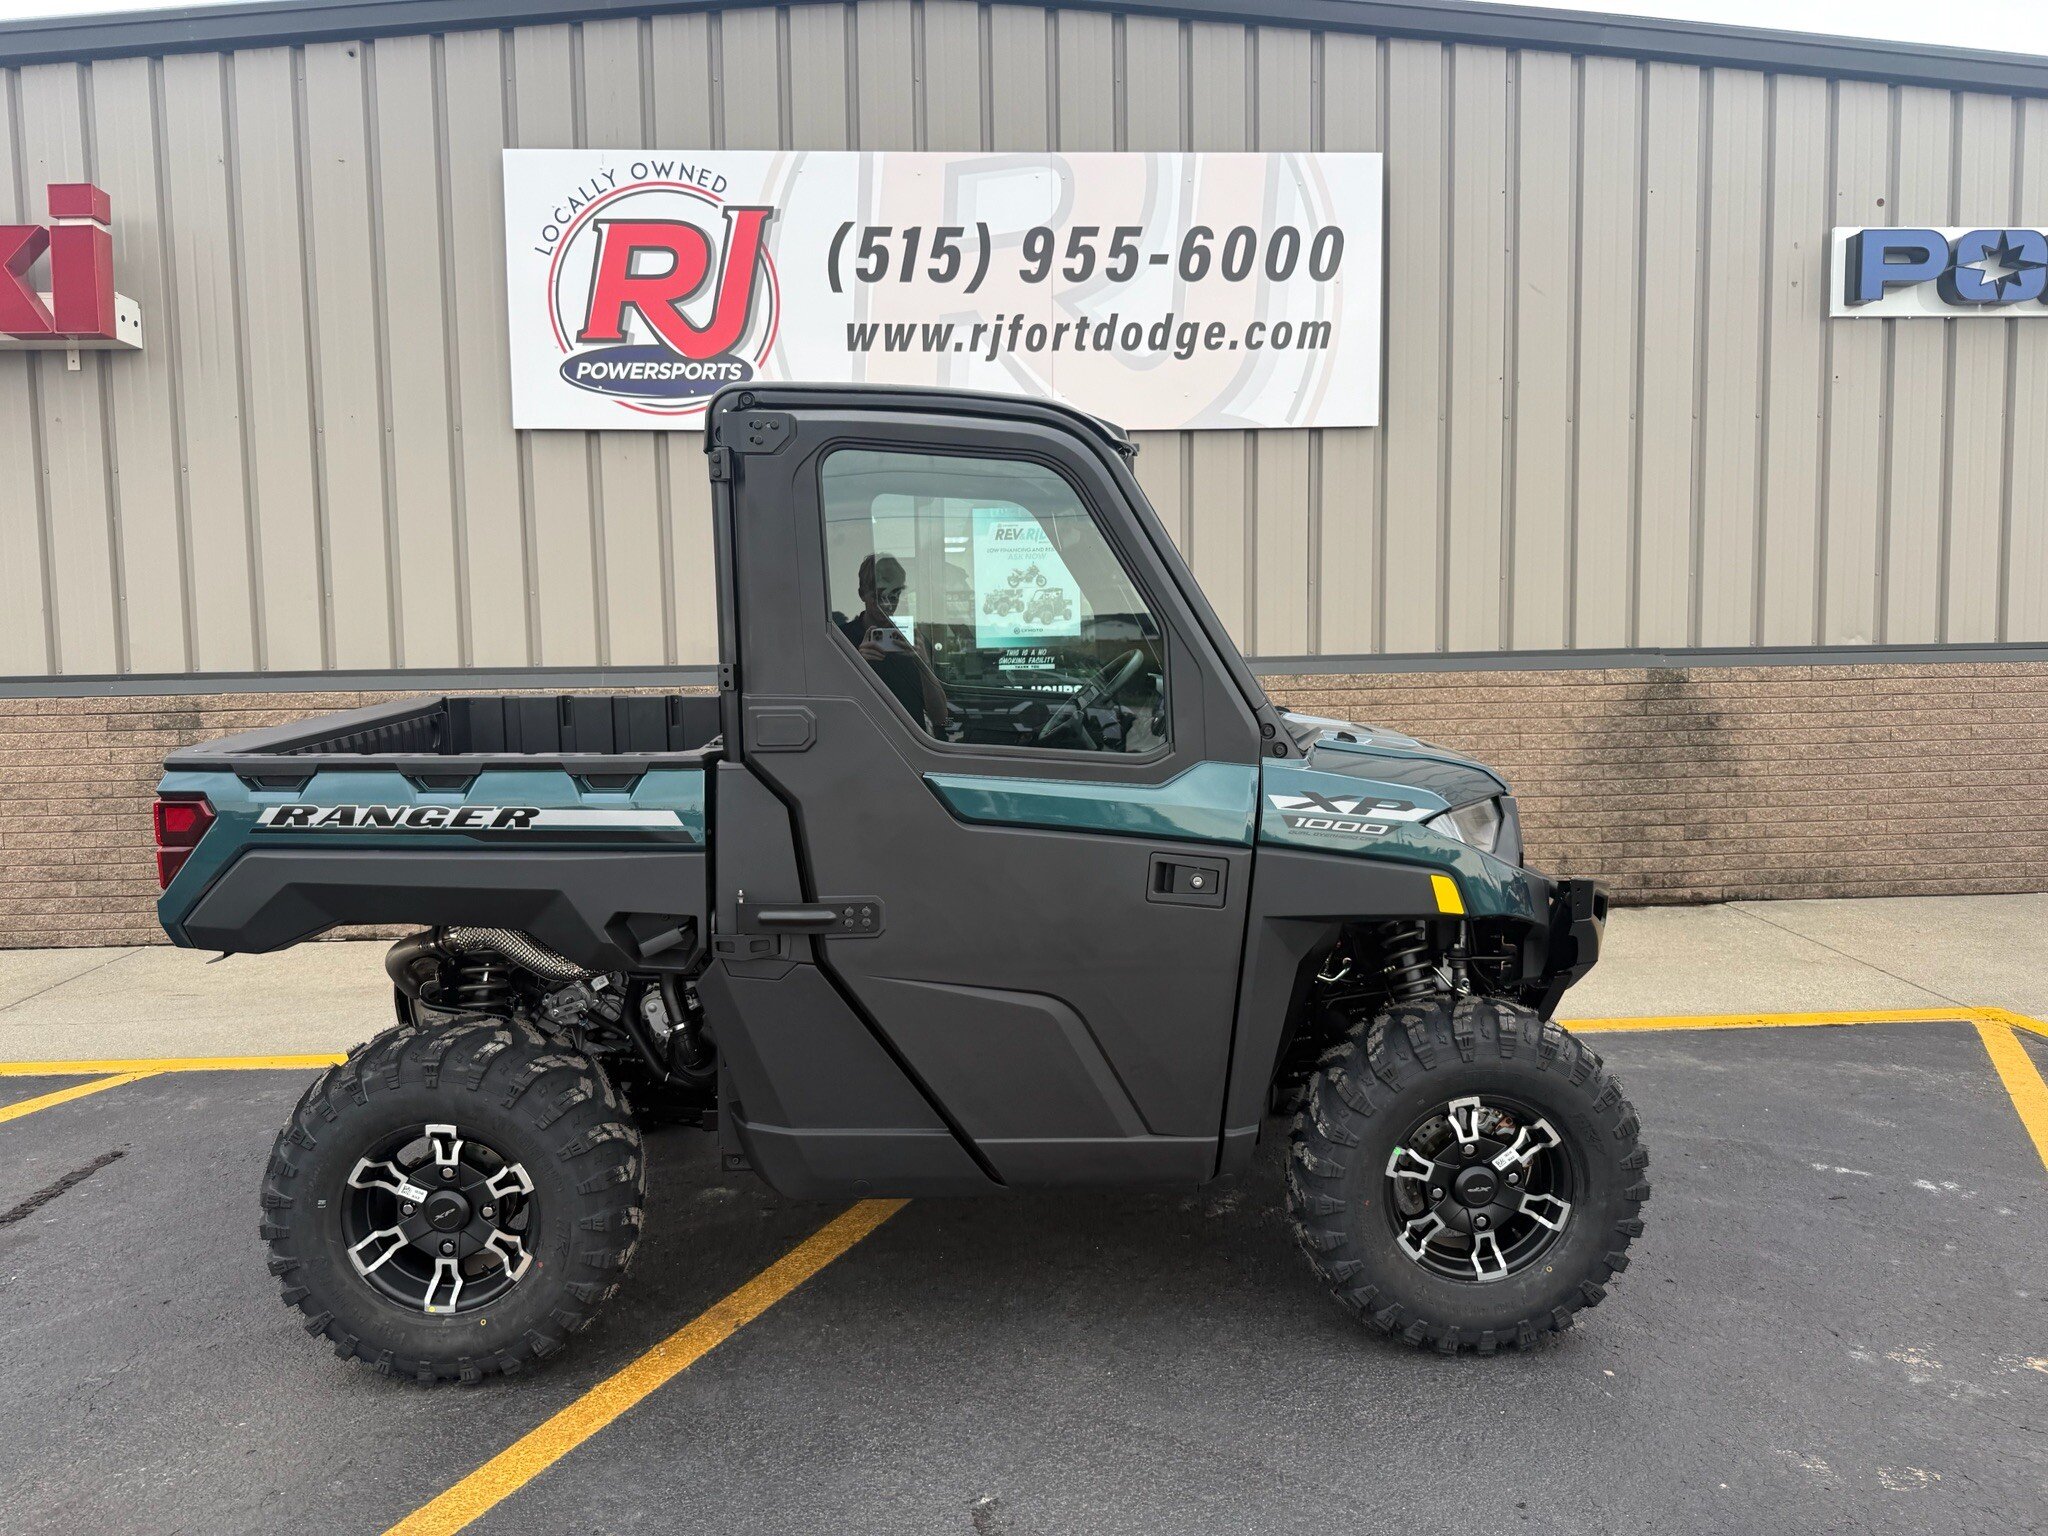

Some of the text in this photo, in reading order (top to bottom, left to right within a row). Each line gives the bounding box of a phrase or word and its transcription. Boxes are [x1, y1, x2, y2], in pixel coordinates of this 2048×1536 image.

[534, 159, 729, 257] LOCALLY OWNED
[826, 221, 1345, 294] (515) 955-6000
[575, 205, 776, 361] RJ
[845, 312, 1333, 362] www.rjfortdodge.com
[575, 360, 743, 382] POWERSPORTS
[1025, 552, 1047, 560] NOW
[998, 656, 1055, 664] SMOKING FACILITY
[1037, 648, 1047, 656] NO
[1283, 790, 1417, 815] XP
[268, 804, 541, 829] RANGER
[1293, 817, 1390, 835] 1000
